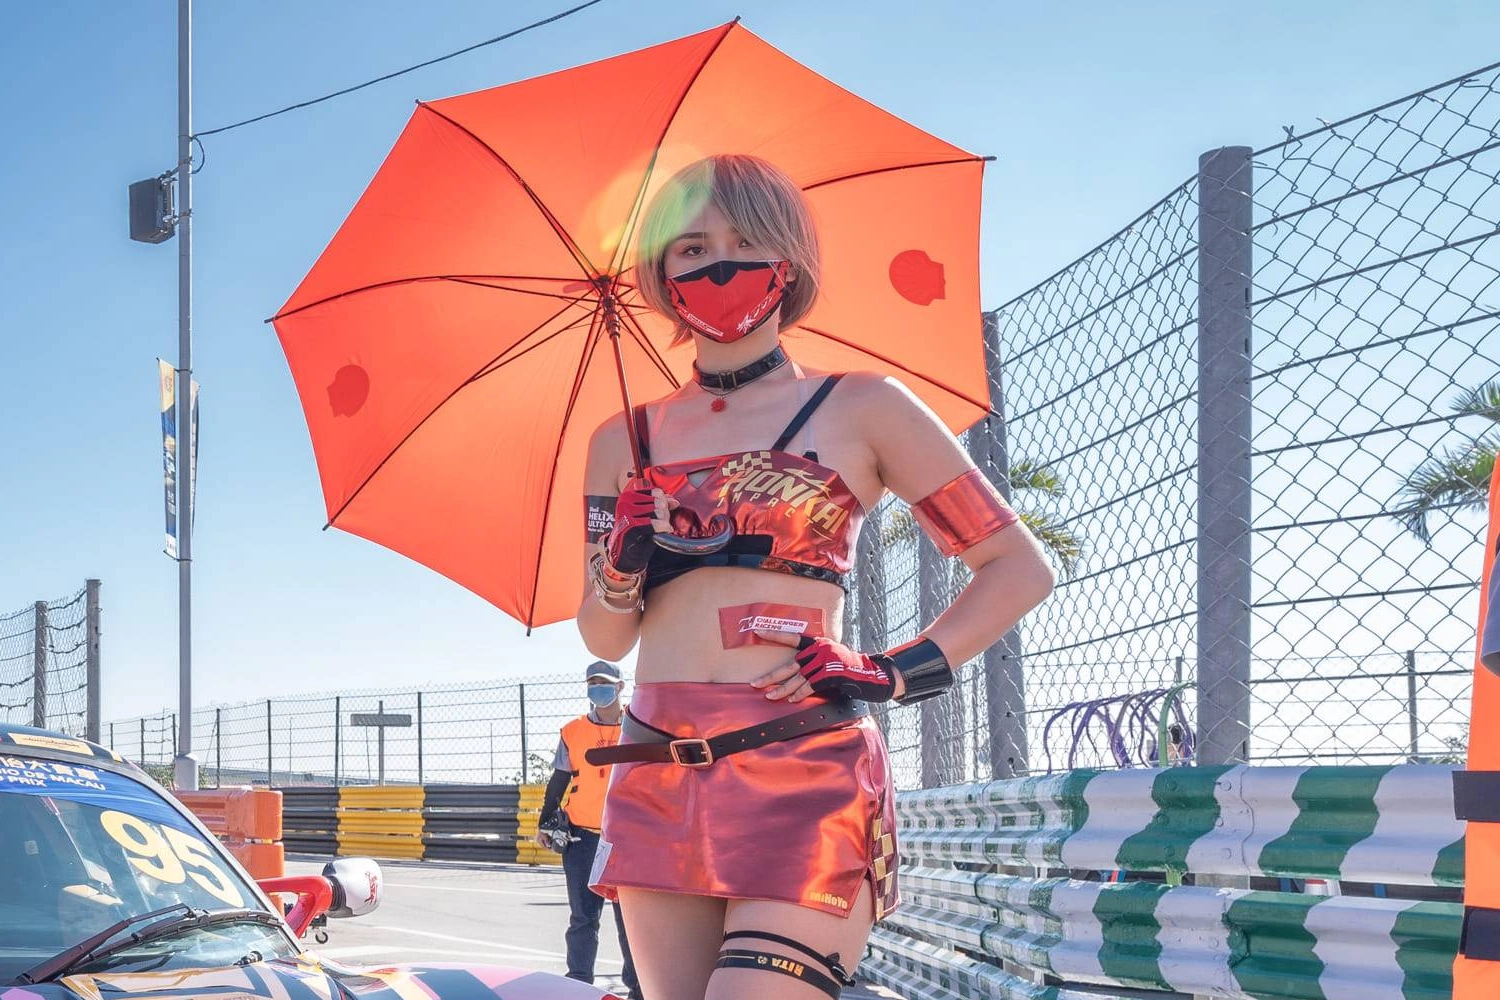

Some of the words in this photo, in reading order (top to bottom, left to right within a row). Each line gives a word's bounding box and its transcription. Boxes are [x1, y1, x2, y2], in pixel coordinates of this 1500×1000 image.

[718, 468, 850, 534] HONKAI
[588, 510, 616, 522] HELIX
[717, 492, 814, 528] IMPACT
[588, 520, 613, 529] ULTRA
[8, 775, 48, 788] PRIX
[49, 774, 106, 791] MACAU
[100, 810, 244, 908] 95
